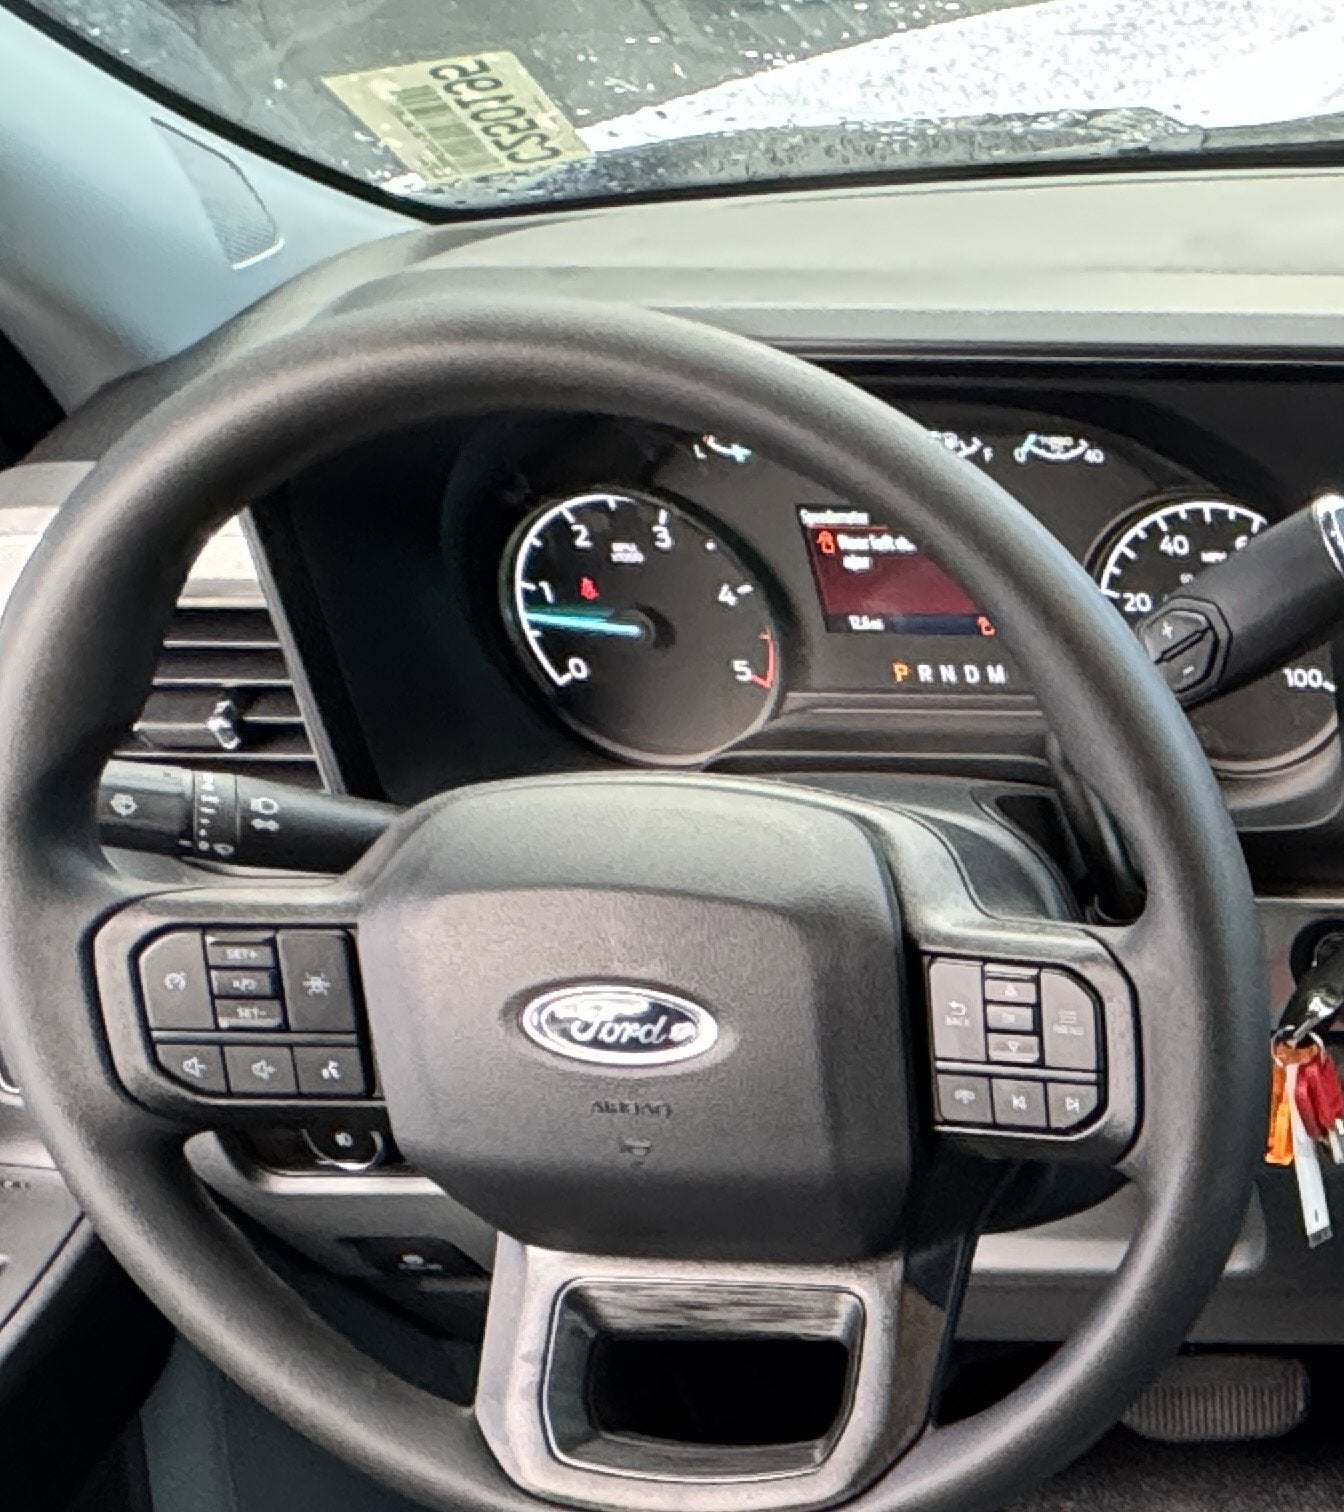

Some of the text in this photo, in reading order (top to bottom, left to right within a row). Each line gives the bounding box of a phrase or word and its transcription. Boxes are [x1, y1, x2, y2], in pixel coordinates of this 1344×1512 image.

[571, 525, 593, 549] 2
[652, 526, 675, 550] 3
[1159, 535, 1190, 556] 40
[539, 580, 555, 604] 1
[718, 584, 738, 607] 4
[1123, 593, 1152, 612] 20
[567, 657, 590, 681] 0
[732, 660, 753, 682] 5
[893, 663, 1008, 684] P R N D M
[1283, 667, 1324, 689] 100
[548, 999, 671, 1045] Ford
